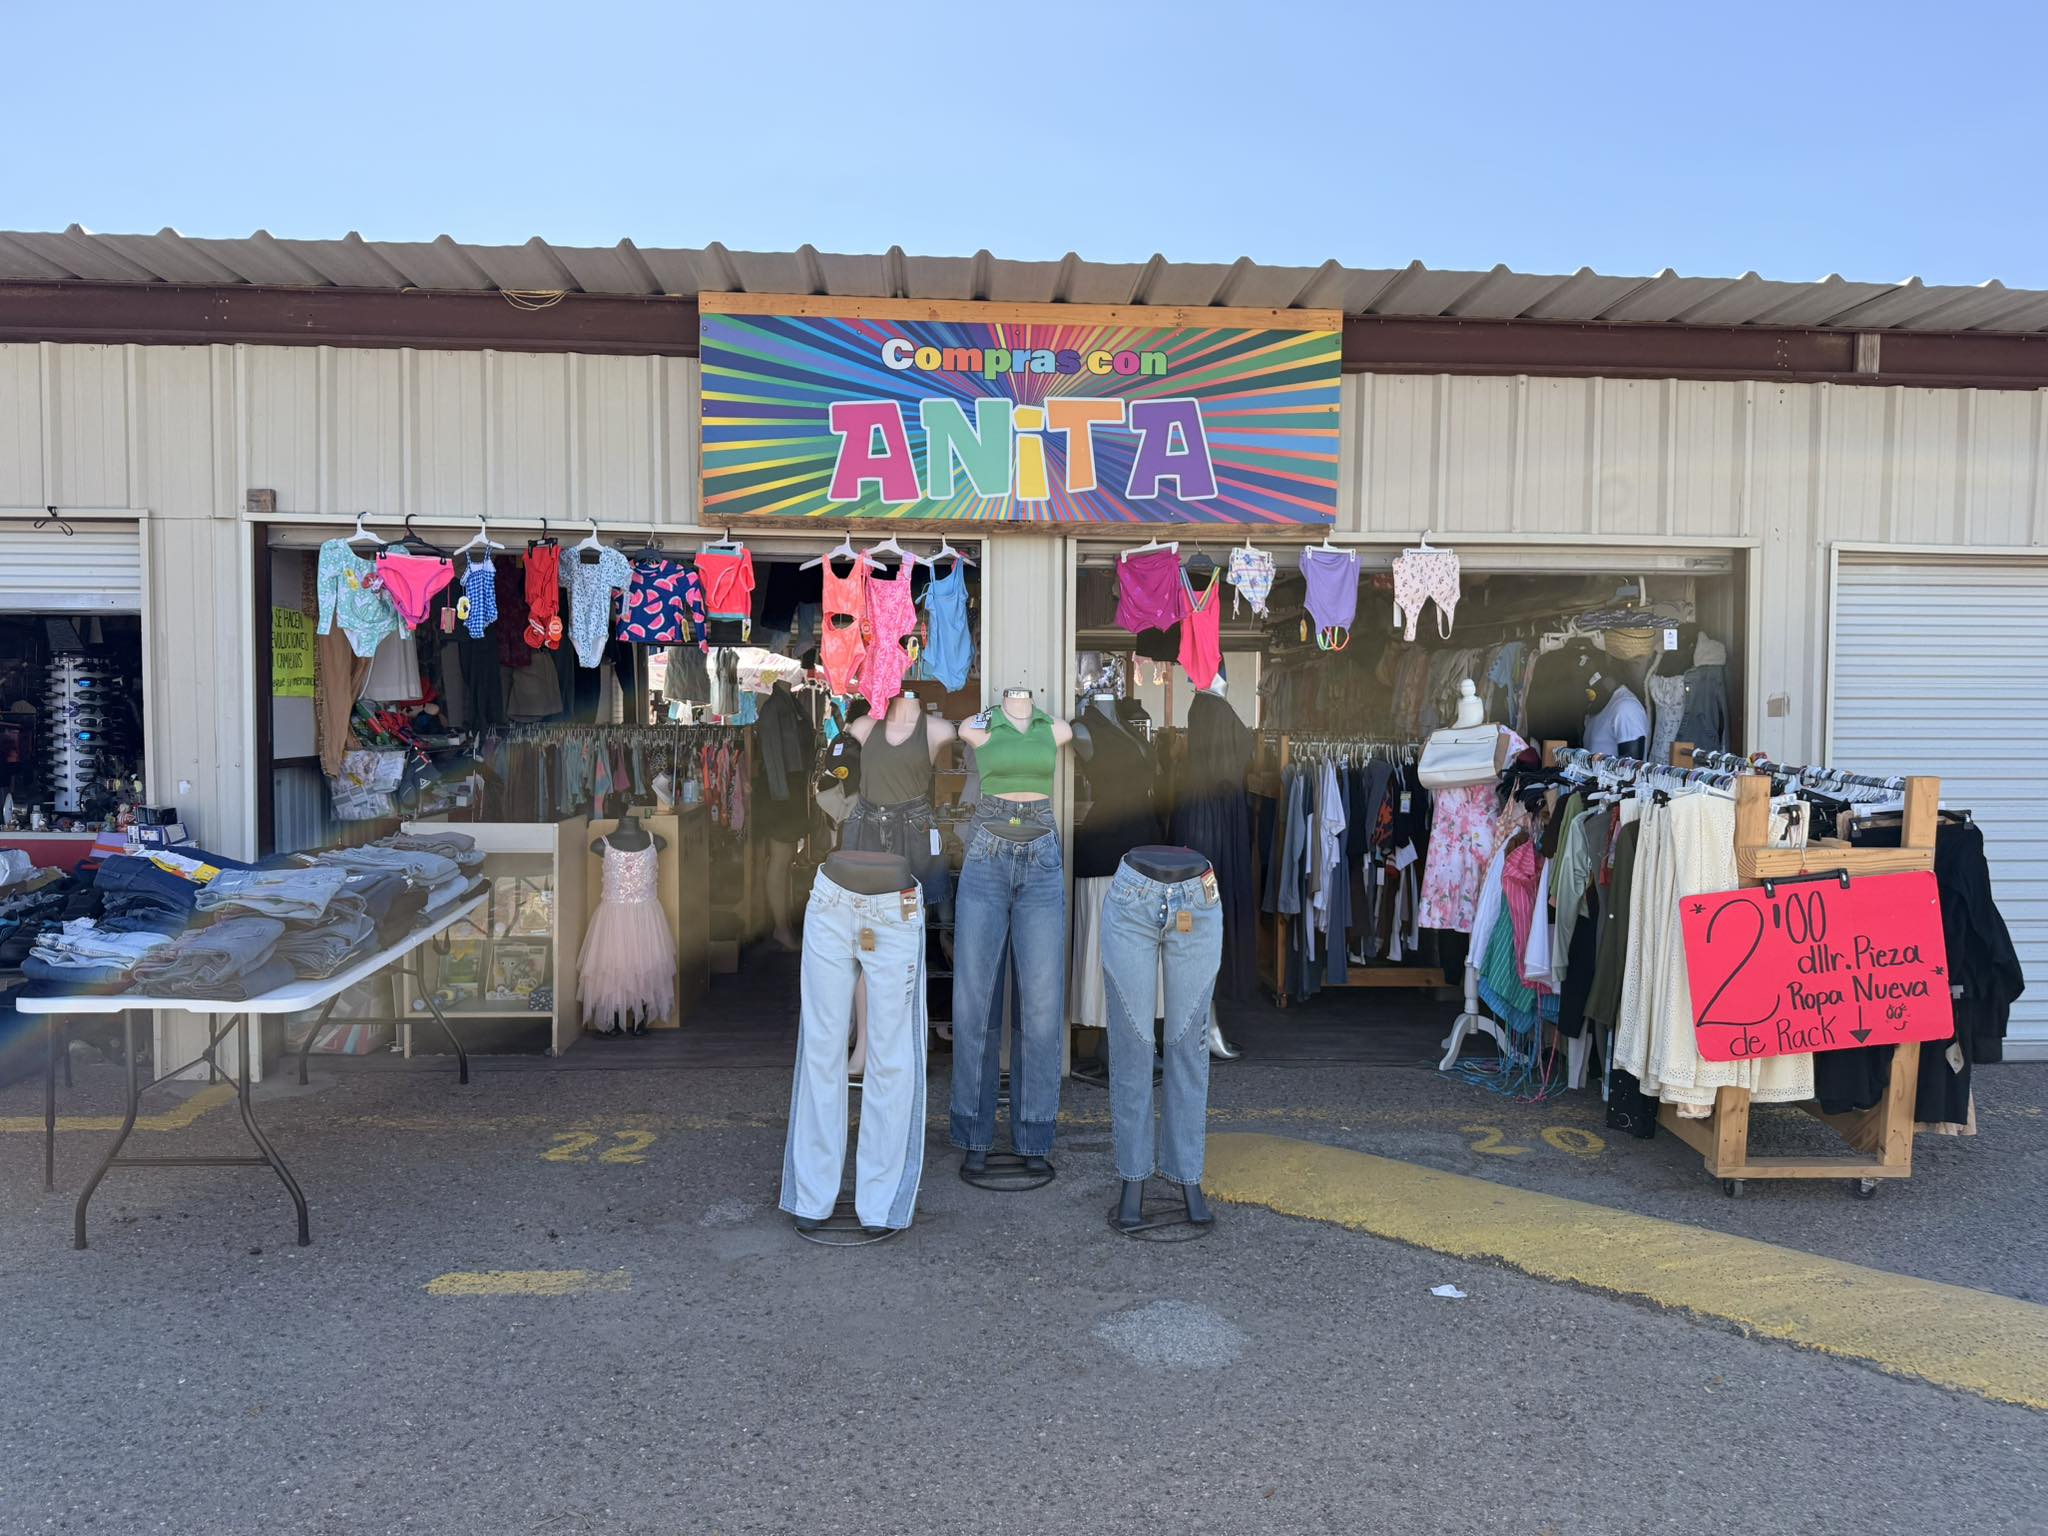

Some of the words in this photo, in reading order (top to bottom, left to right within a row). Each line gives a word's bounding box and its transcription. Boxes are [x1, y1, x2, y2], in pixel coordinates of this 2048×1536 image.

[881, 336, 1081, 380] Compras
[1087, 346, 1168, 376] con
[275, 608, 282, 629] SE
[283, 610, 304, 630] HACEN
[1854, 935, 1925, 970] Pieza
[1786, 981, 1845, 1016] Ropa
[1852, 972, 1930, 1003] Nueva
[1729, 1027, 1766, 1057] de
[1776, 1015, 1837, 1052] Rack
[537, 1129, 657, 1165] 22
[1457, 1125, 1607, 1158] 20
